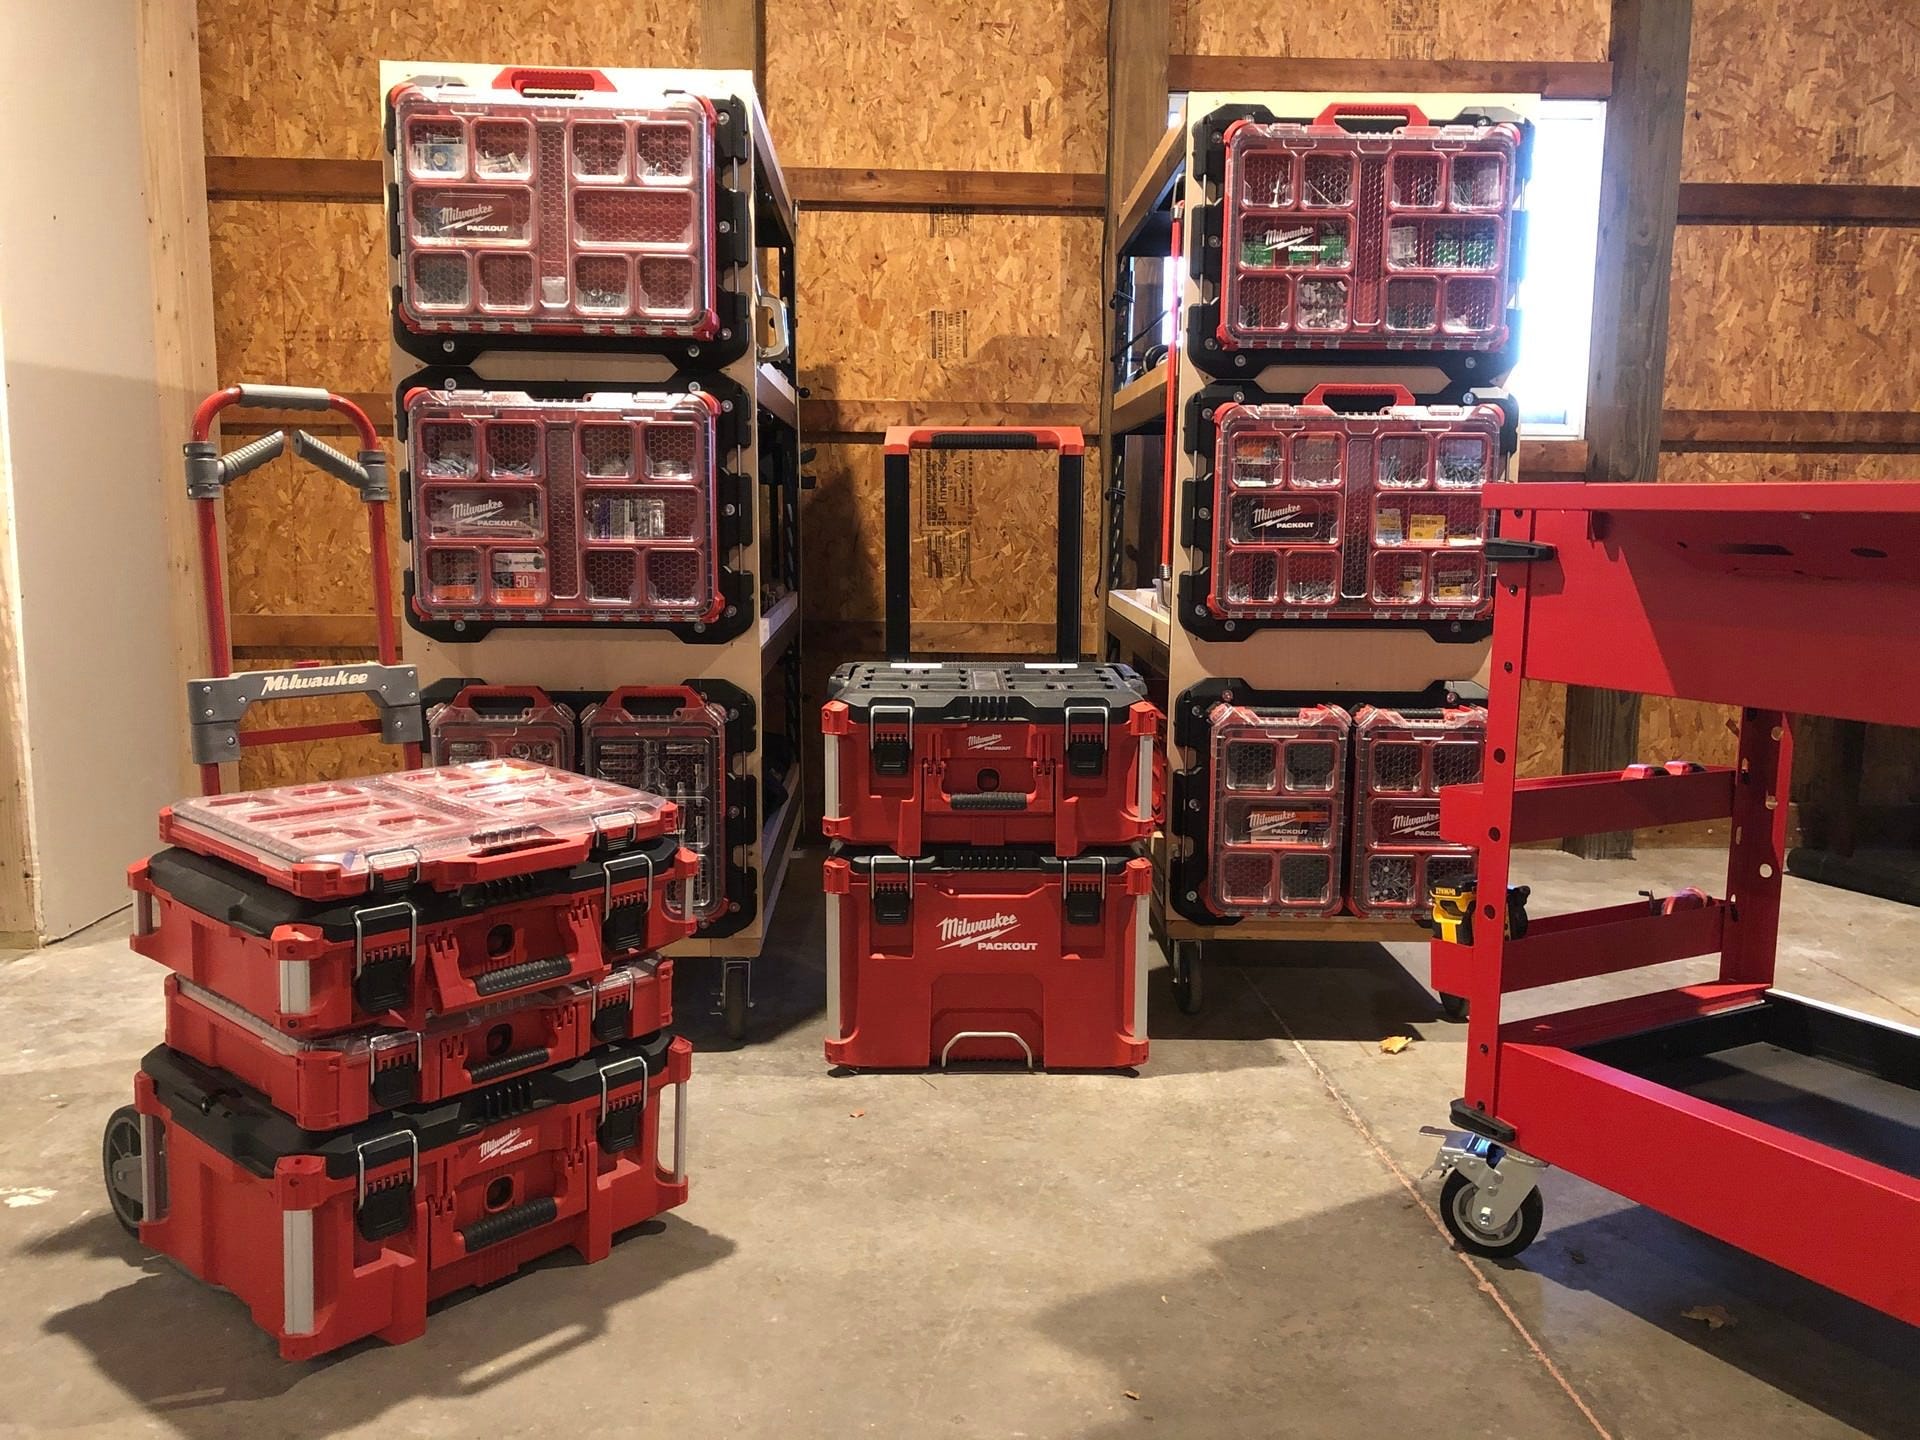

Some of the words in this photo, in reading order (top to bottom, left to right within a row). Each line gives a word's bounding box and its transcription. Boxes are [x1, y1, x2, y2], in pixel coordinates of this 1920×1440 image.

[439, 203, 494, 225] Milwaukee
[1263, 225, 1315, 246] Milwaukee
[449, 499, 504, 520] Milwaukee
[1252, 503, 1302, 524] Milwaukee
[515, 575, 529, 588] 50
[260, 670, 369, 697] Milwaukee
[966, 733, 1002, 747] Milwaukee
[1246, 810, 1297, 828] Milwaukee
[1391, 812, 1440, 830] Milwaukee
[936, 912, 1018, 942] Milwaukee
[977, 942, 1039, 951] PACKOUT
[479, 1127, 521, 1158] Milwaukee
[500, 1138, 533, 1156] PACKOUT
